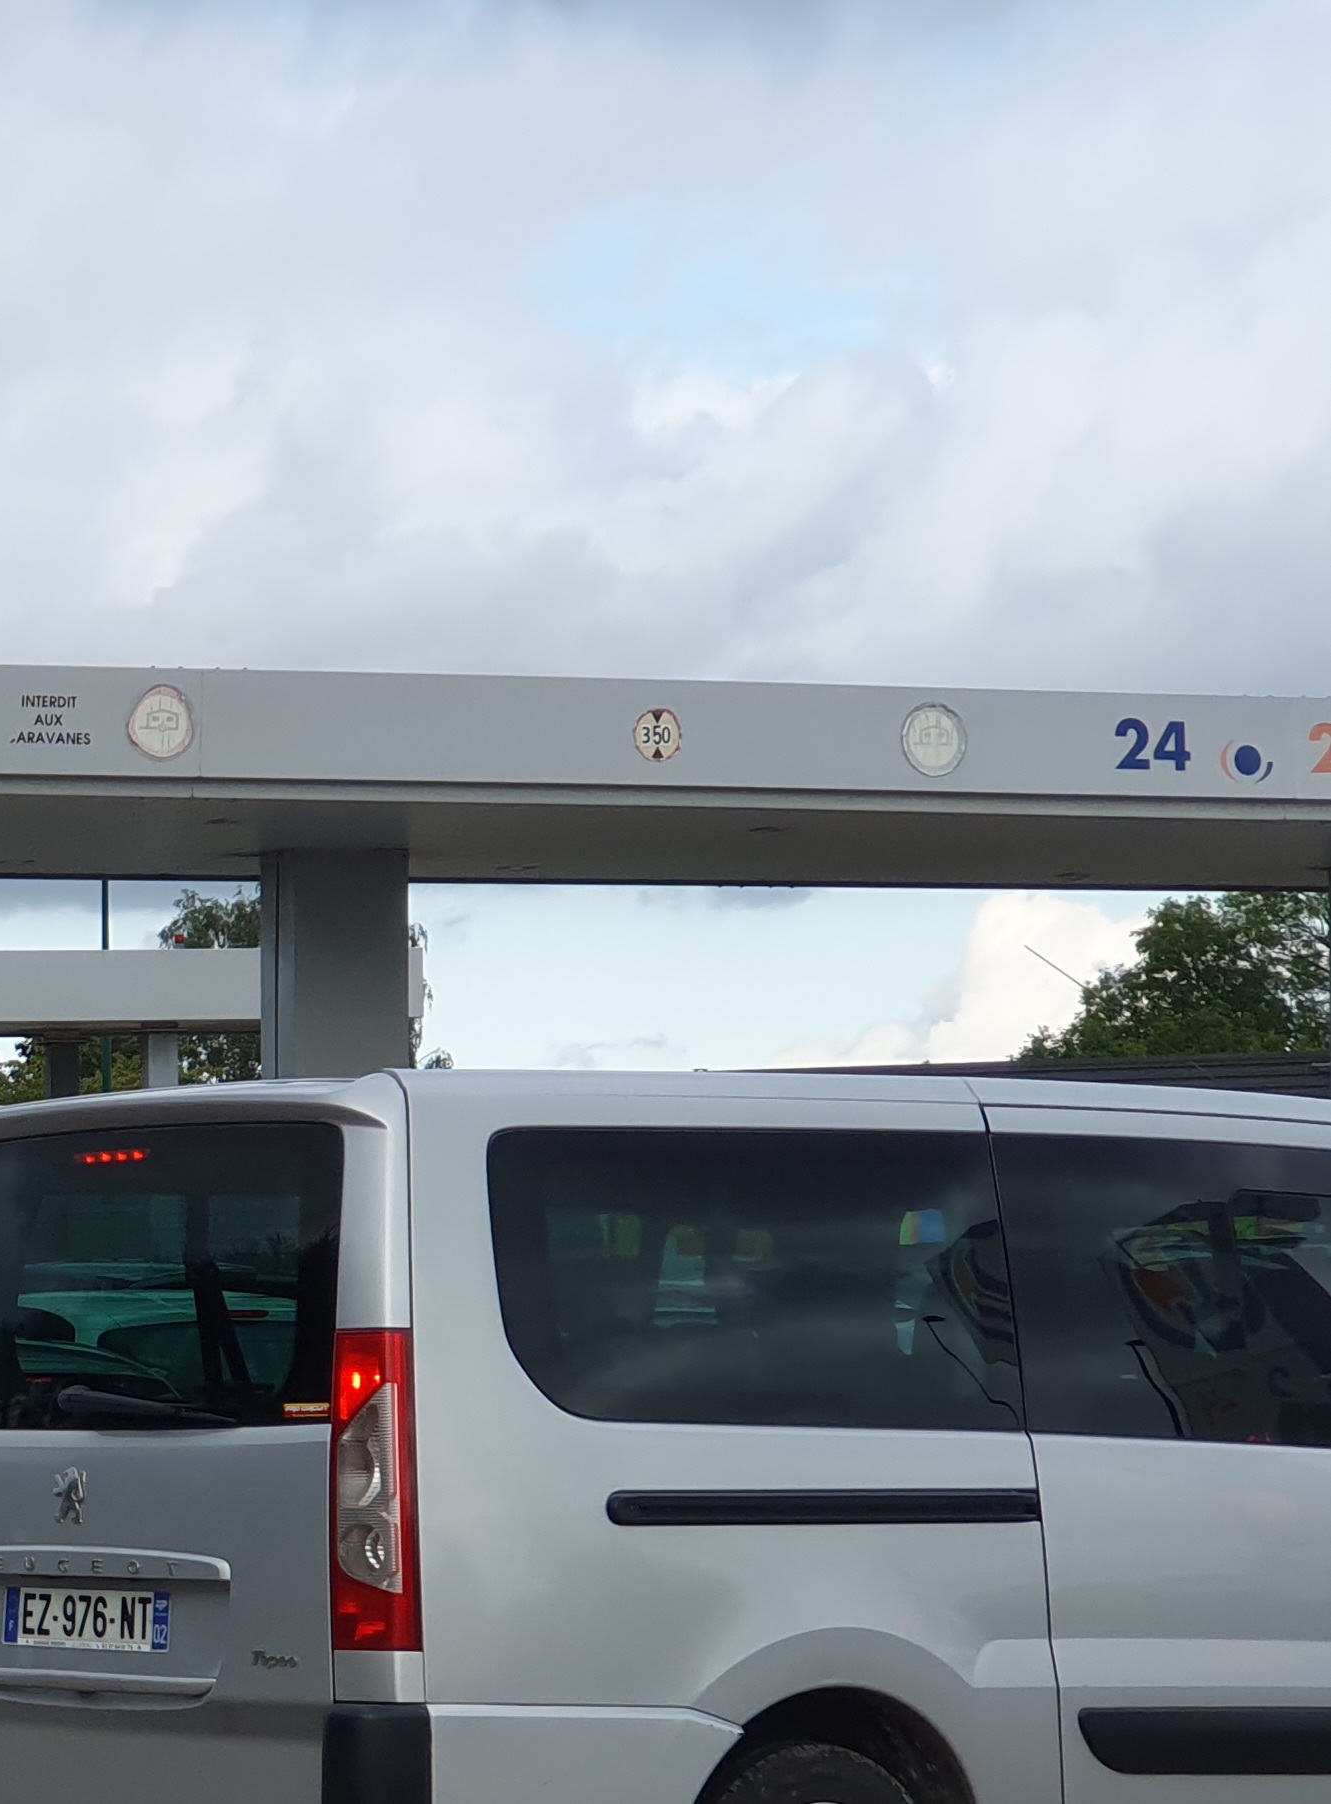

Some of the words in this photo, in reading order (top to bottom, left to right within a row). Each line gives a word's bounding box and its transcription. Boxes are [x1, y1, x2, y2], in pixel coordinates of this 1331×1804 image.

[21, 694, 77, 708] INTERDIT
[34, 713, 64, 726] AUX
[10, 731, 91, 745] ARAVANES
[641, 725, 671, 745] 350
[1114, 718, 1191, 771] 24
[22, 1592, 152, 1640] EZ-976-NT
[153, 1624, 167, 1644] 02
